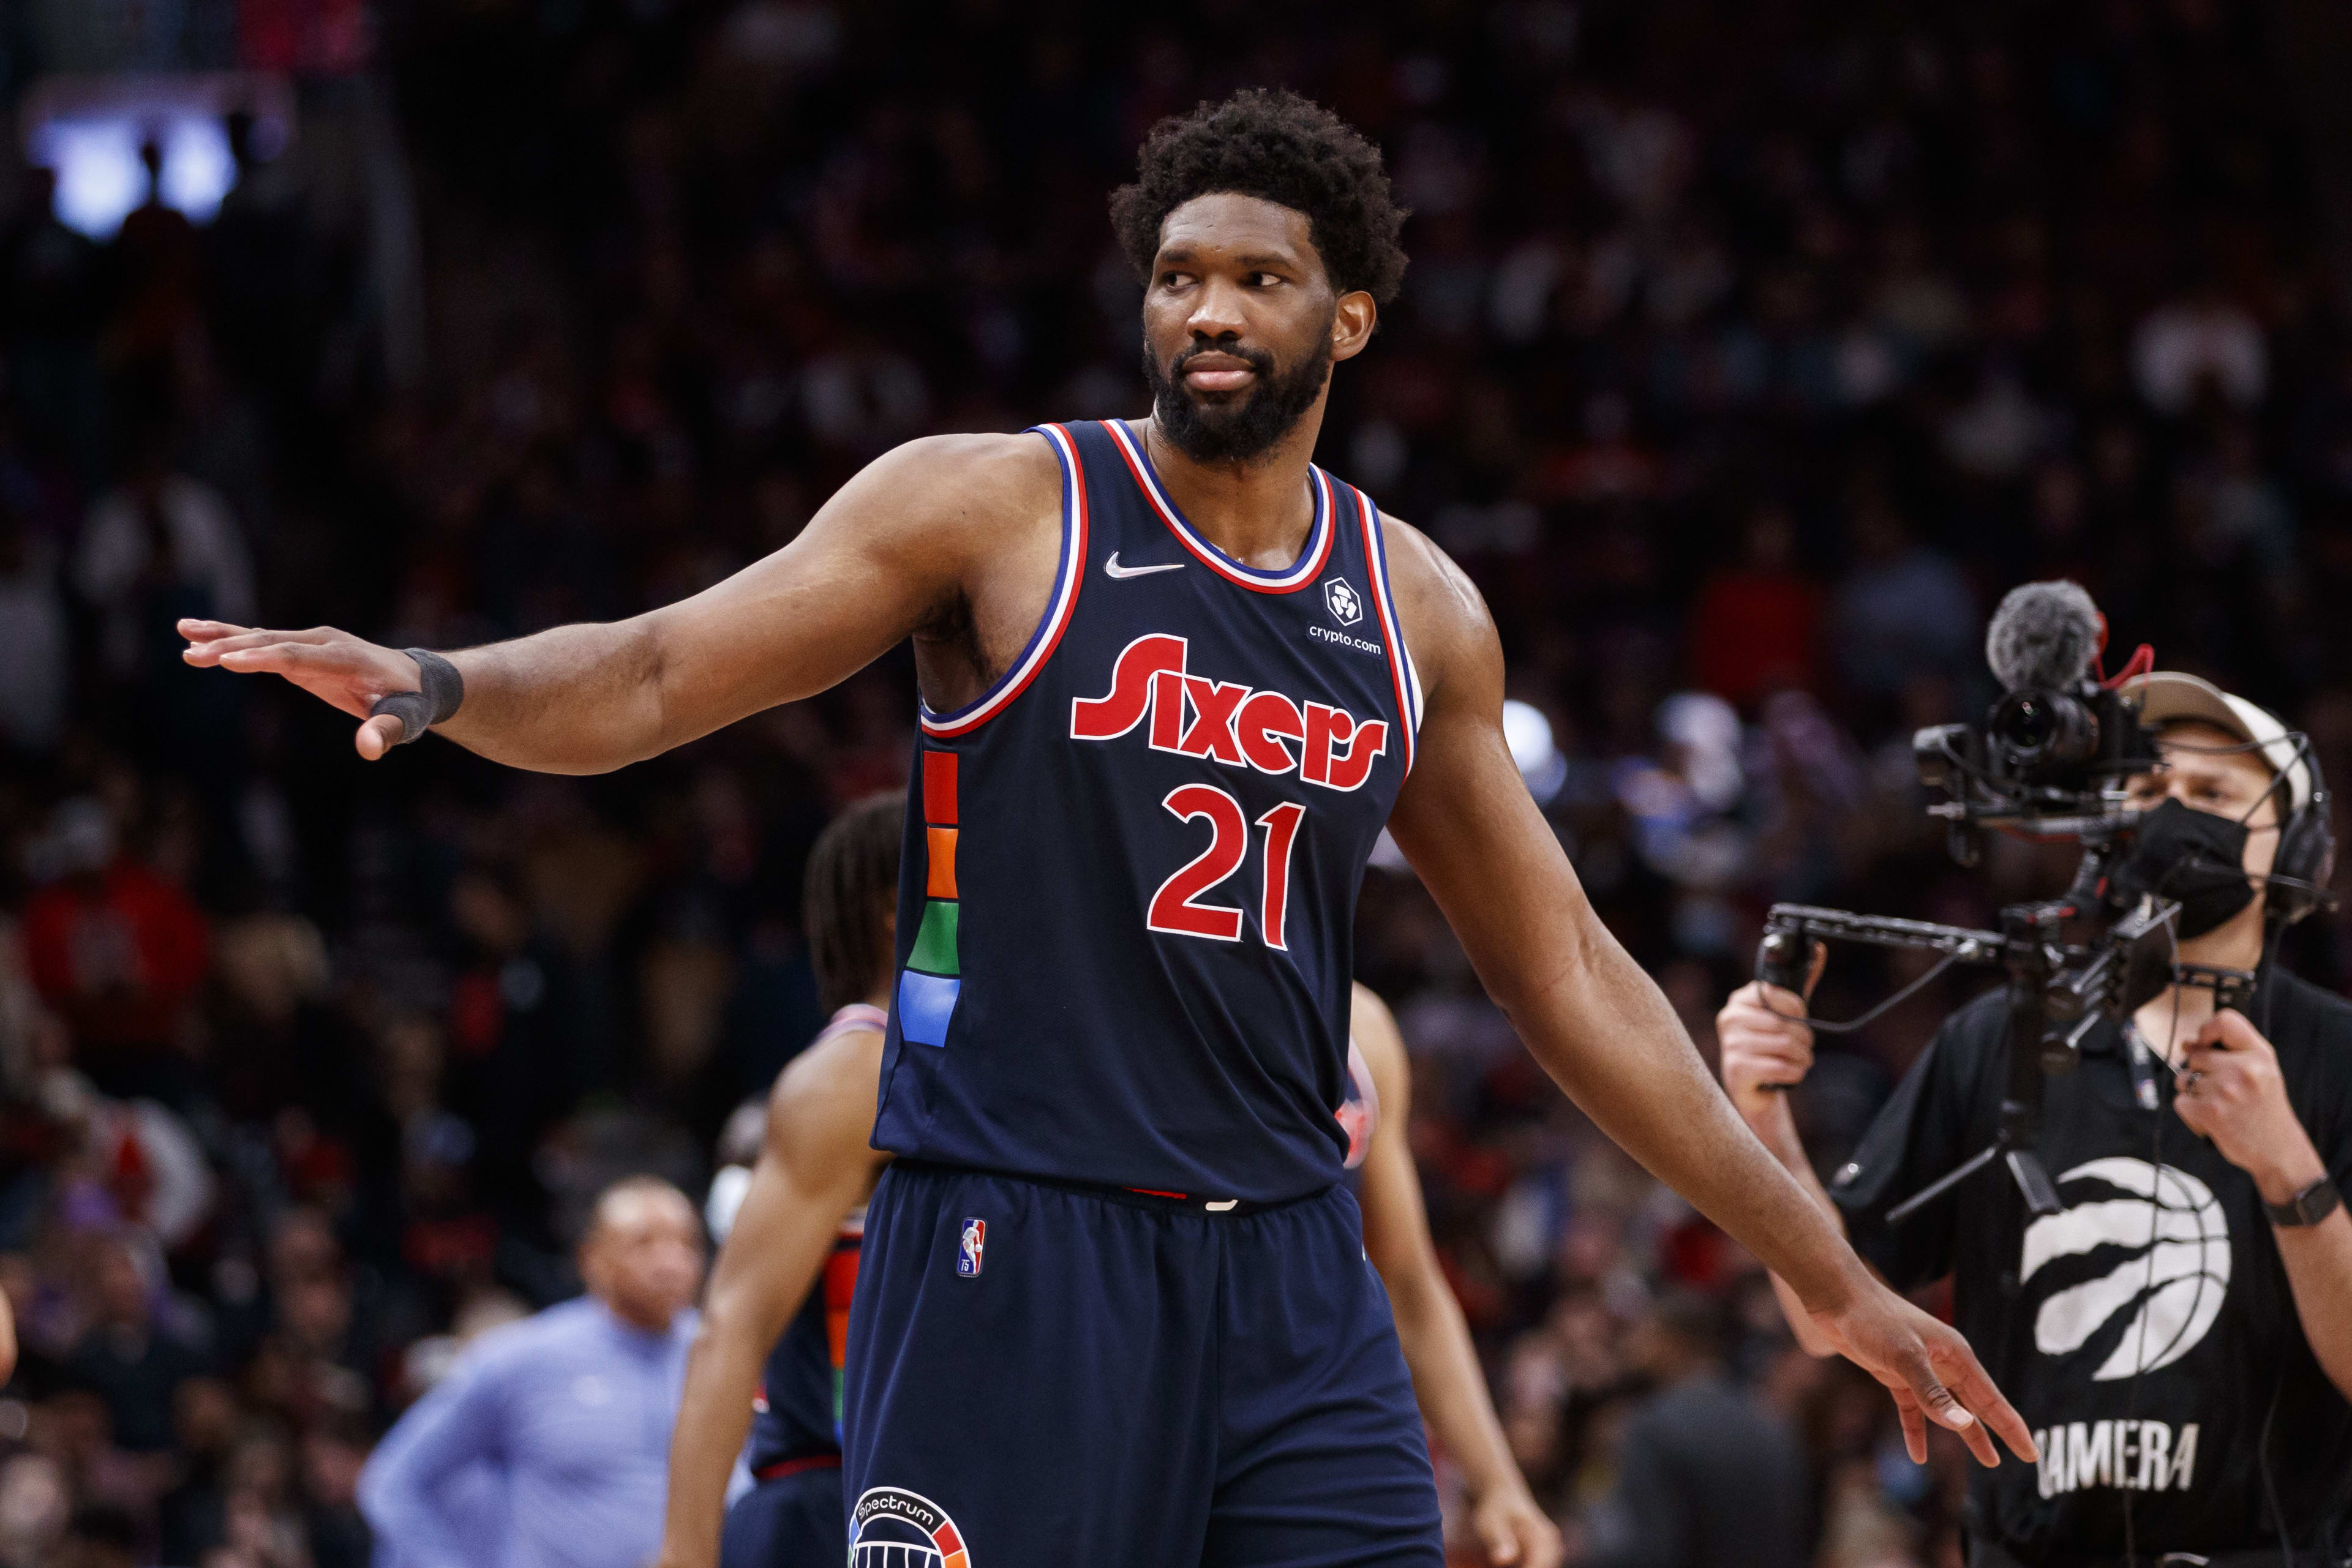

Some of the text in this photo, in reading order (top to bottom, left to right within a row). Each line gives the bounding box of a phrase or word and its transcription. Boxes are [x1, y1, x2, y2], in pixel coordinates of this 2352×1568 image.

[1309, 626, 1381, 655] crypto.com
[1070, 633, 1388, 792] Sixers
[1146, 783, 1306, 951] 21
[961, 1259, 970, 1272] 75
[858, 1495, 934, 1526] Spectrum
